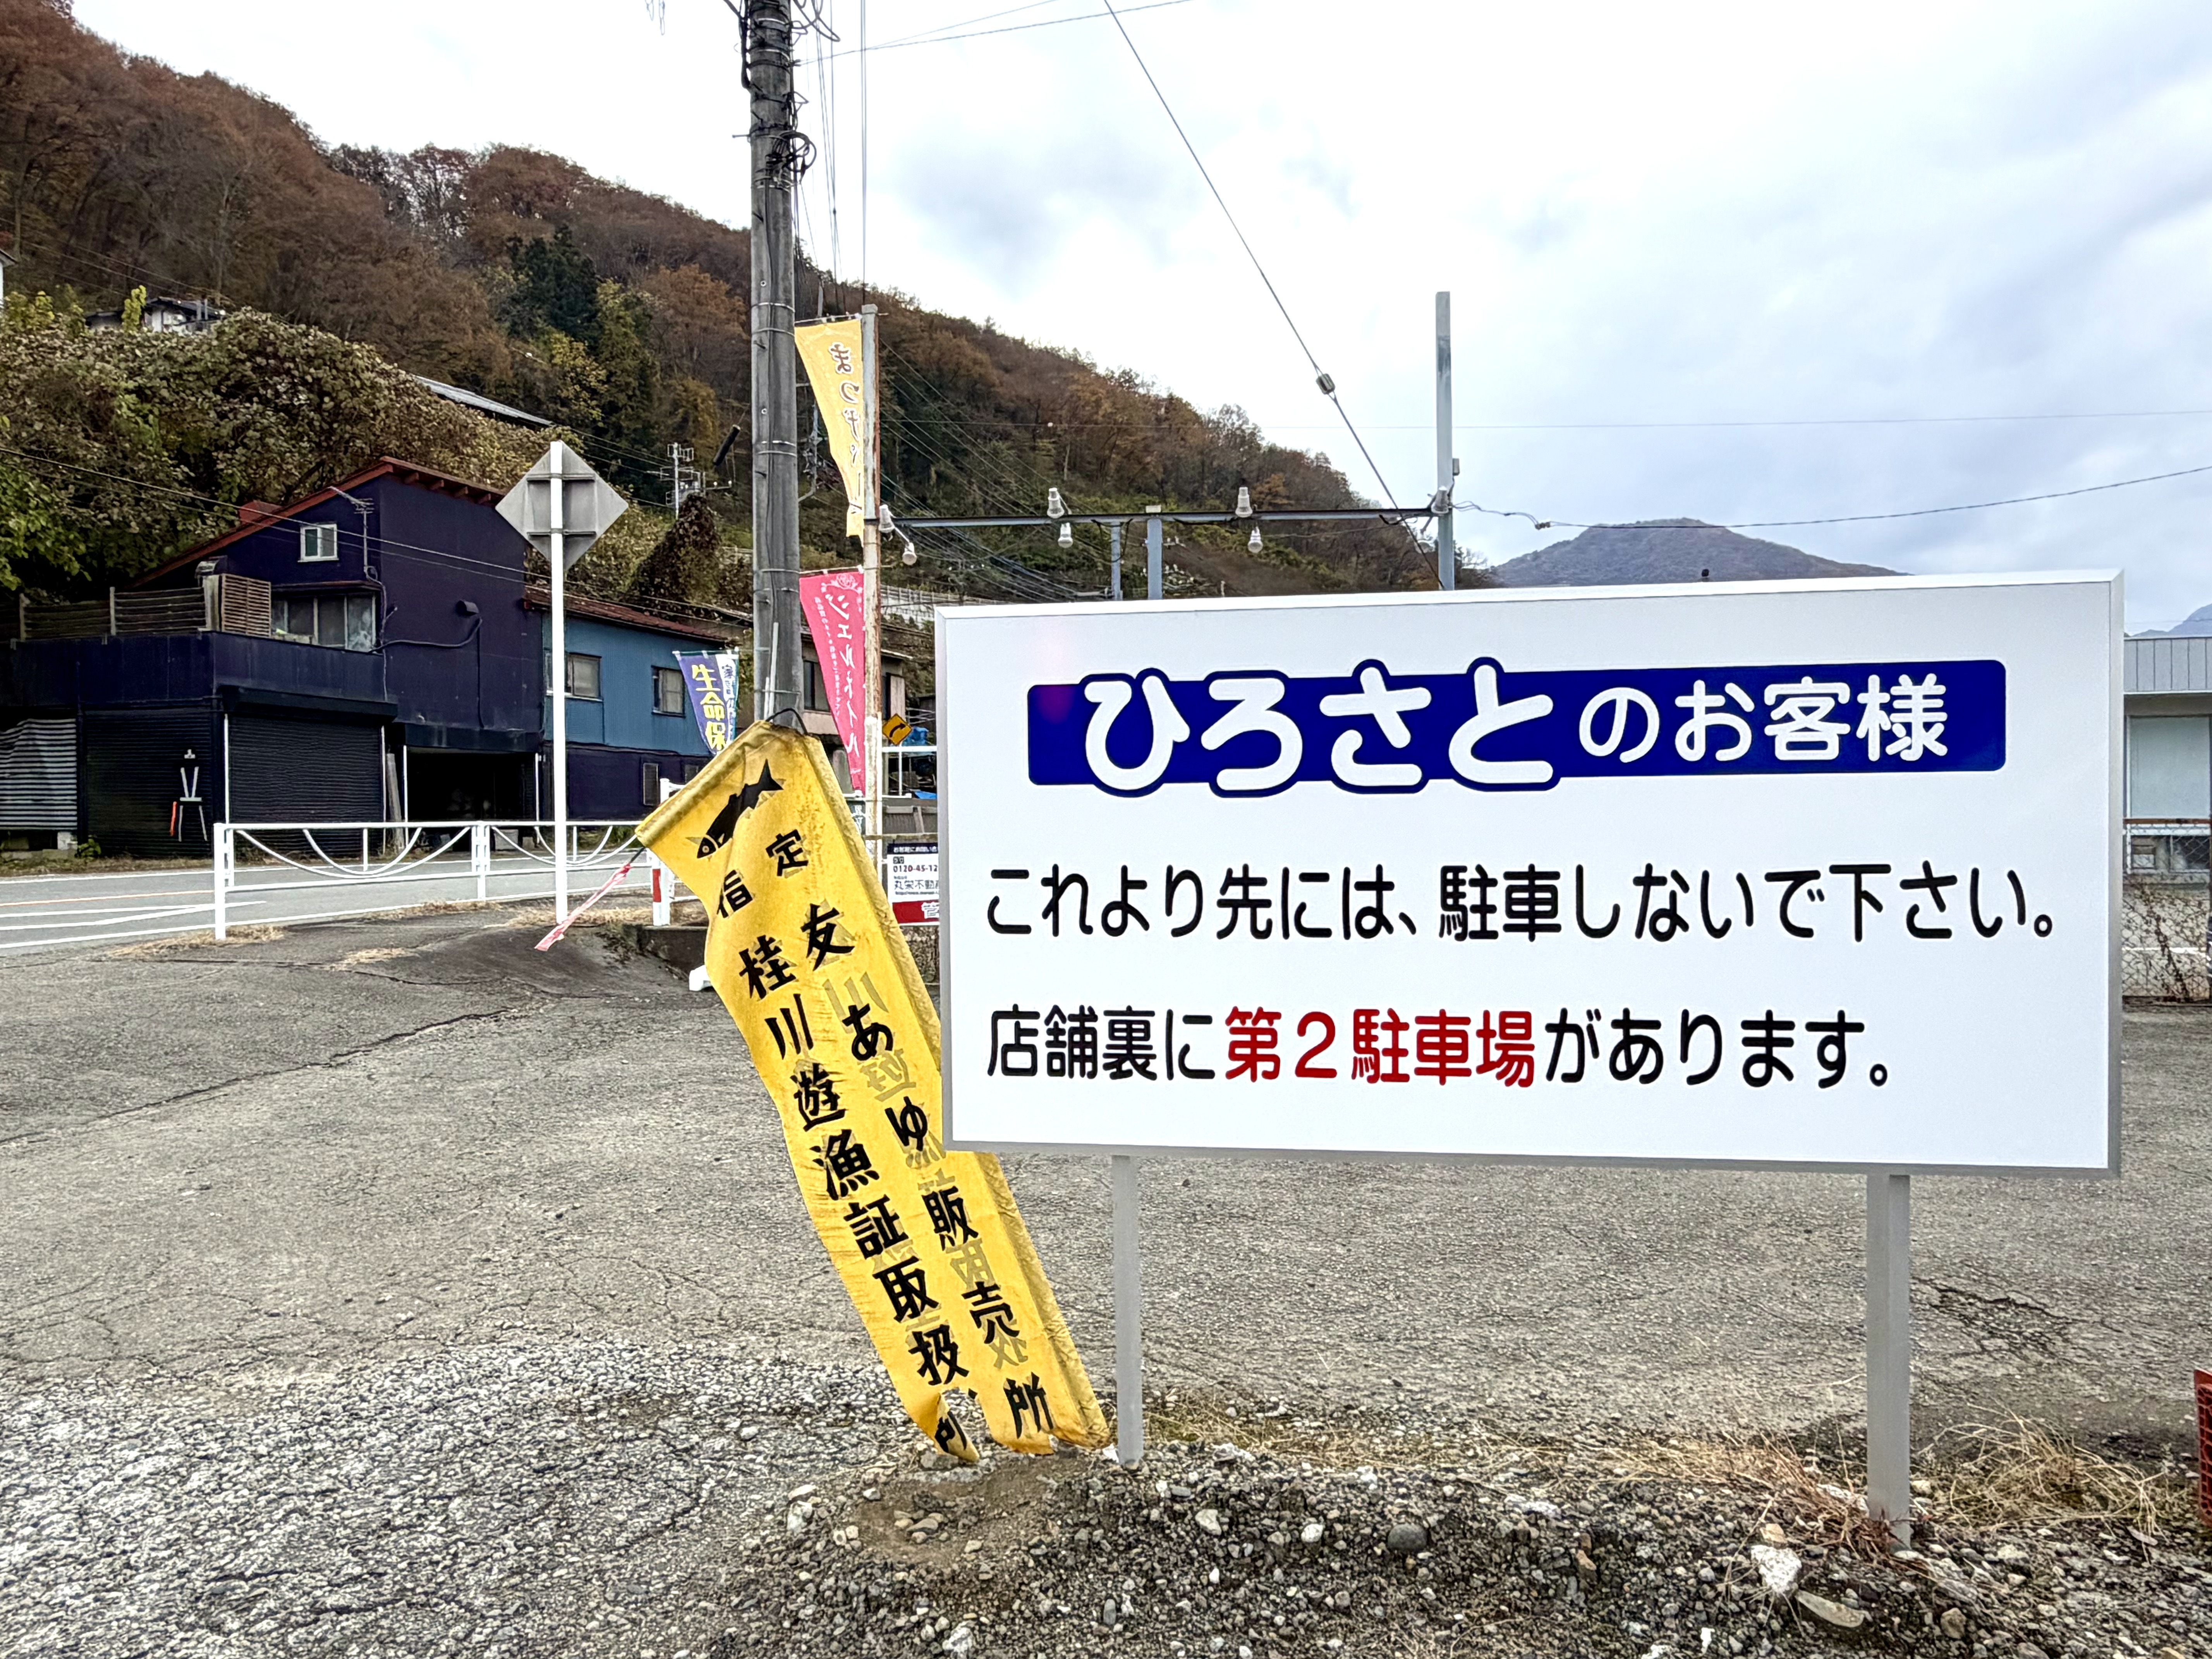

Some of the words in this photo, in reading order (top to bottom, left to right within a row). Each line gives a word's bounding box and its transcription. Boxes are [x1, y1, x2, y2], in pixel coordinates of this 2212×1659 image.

[1085, 665, 1948, 790] ひろさとのお客様
[988, 861, 2052, 942] これより先には、駐車しないで下さい。
